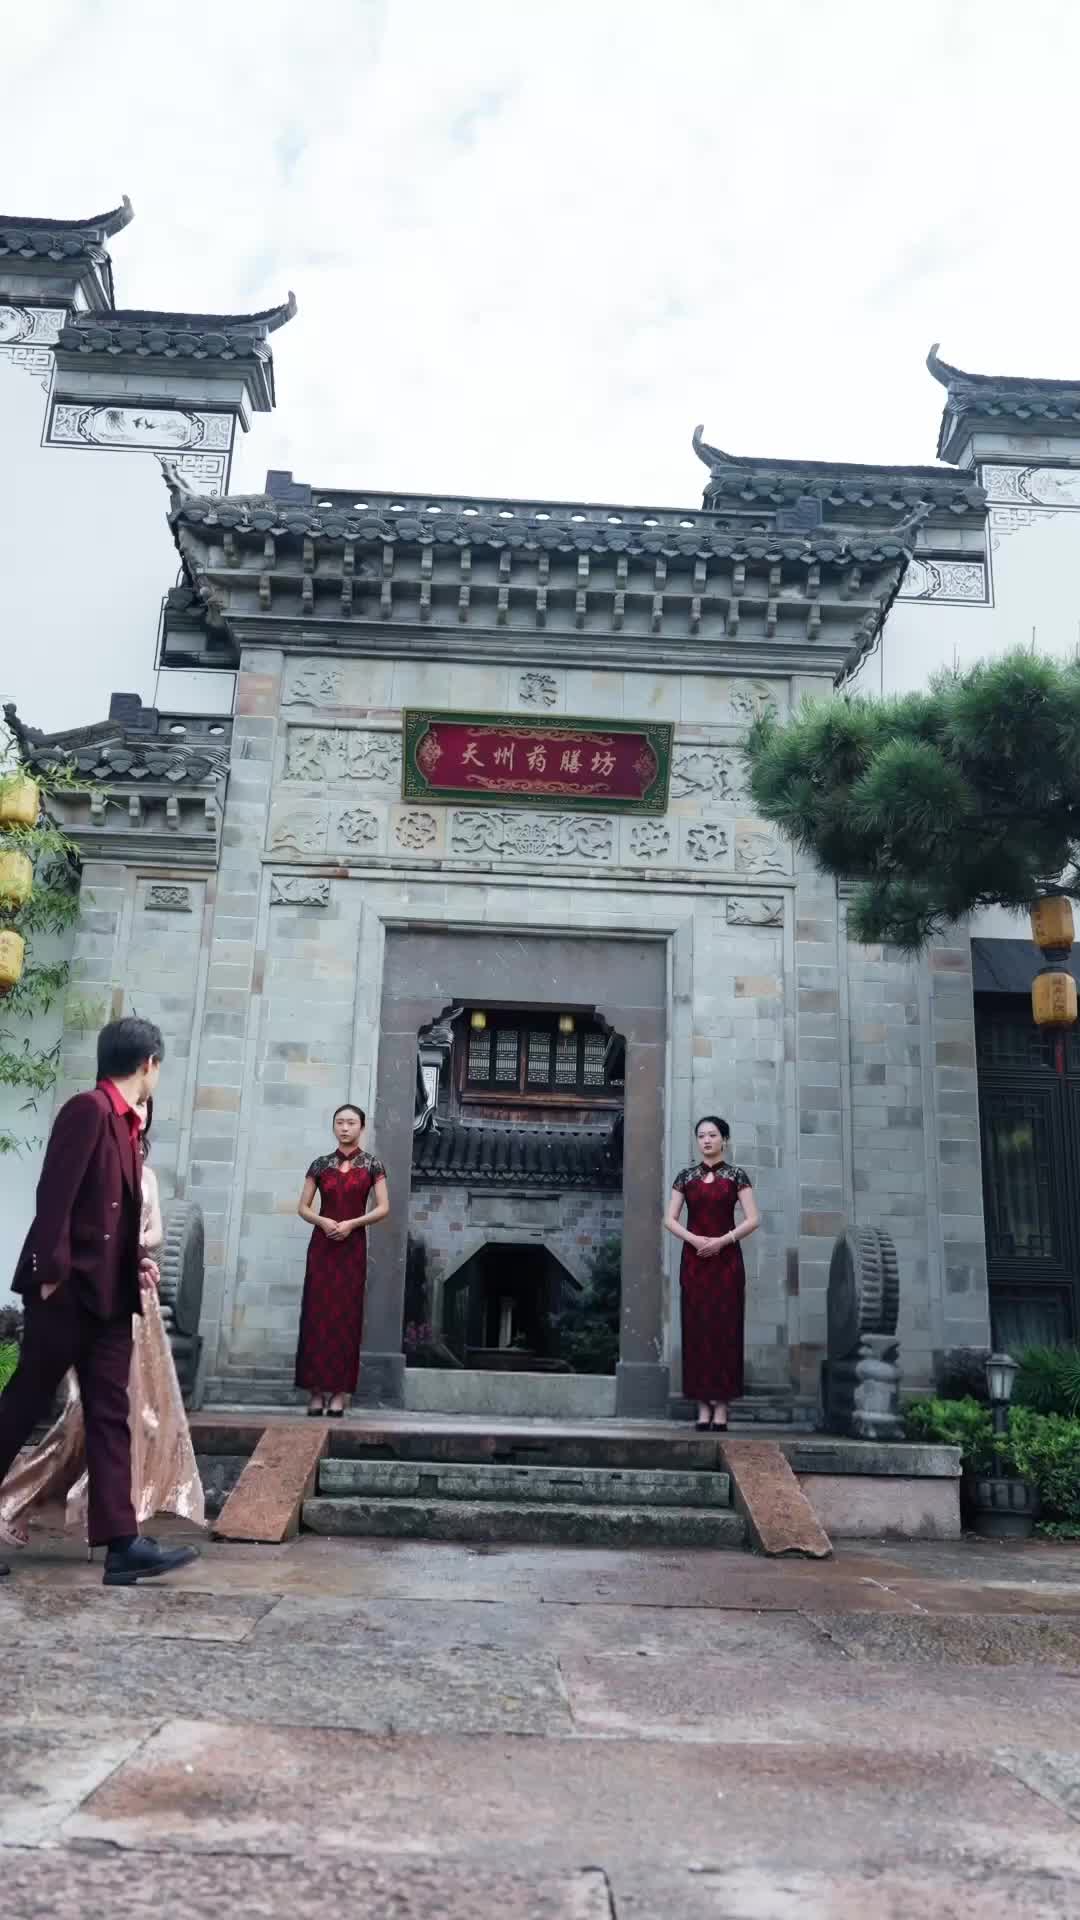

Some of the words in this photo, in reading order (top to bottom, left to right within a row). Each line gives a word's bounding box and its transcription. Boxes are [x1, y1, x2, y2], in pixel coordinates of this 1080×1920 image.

[460, 741, 617, 777] 天州药膳坊
